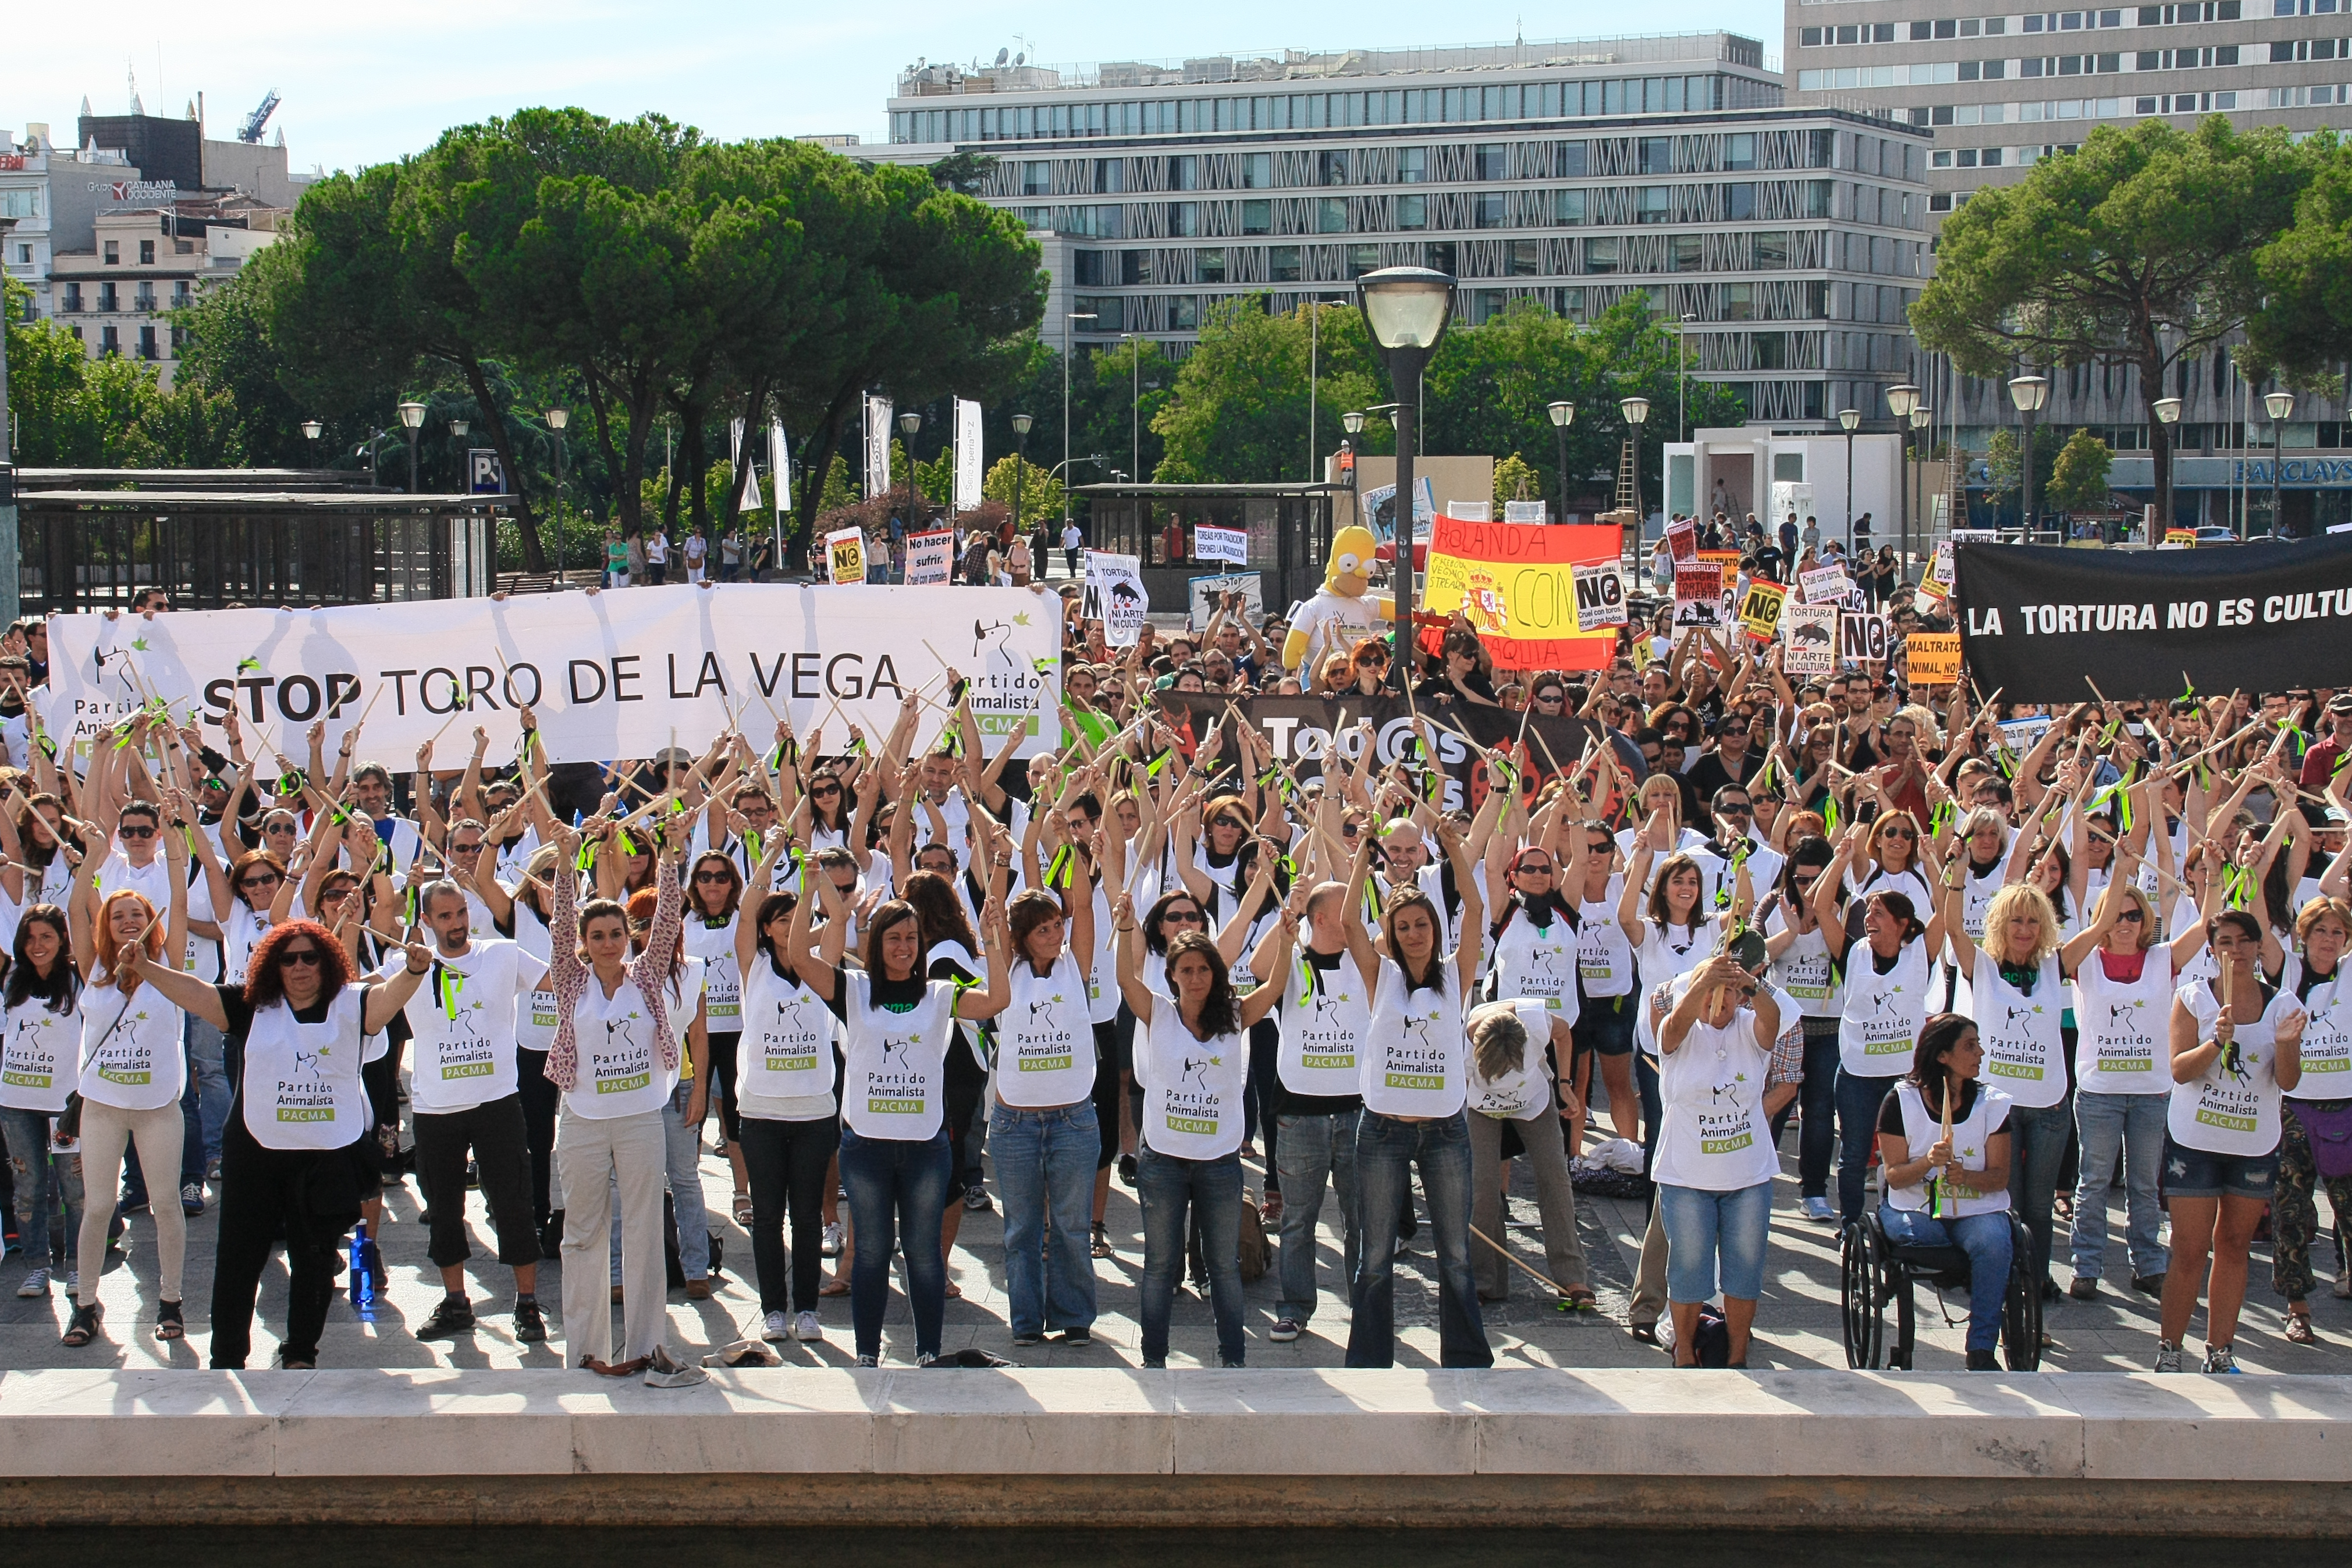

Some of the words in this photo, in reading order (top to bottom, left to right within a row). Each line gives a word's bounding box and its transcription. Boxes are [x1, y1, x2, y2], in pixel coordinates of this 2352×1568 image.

[88, 181, 113, 192] Grupo
[126, 180, 176, 190] CATALANA
[127, 189, 176, 200] OCCIDENTE
[965, 468, 974, 491] Serie
[909, 538, 922, 550] No
[924, 535, 952, 547] hacer
[1214, 532, 1223, 541] POR
[1437, 517, 1547, 556] HOLANDA
[1952, 532, 1963, 543] LOS
[833, 540, 858, 550] TORTURA
[1217, 545, 1223, 553] LA
[834, 547, 859, 568] NO
[1939, 544, 1955, 559] Crue
[916, 554, 943, 567] sufrir.
[1101, 568, 1134, 579] TORTURA
[1601, 566, 1616, 574] ANIMAL
[1676, 564, 1720, 573] TORDESILLAS:
[1937, 567, 1954, 580] cruel
[907, 573, 919, 585] Cruel
[919, 574, 928, 585] con
[1677, 573, 1719, 582] SANGRE
[1802, 574, 1817, 586] Cruel
[1817, 573, 1827, 583] con
[1826, 568, 1843, 581] toros,
[1576, 574, 1621, 610] NO
[1677, 582, 1719, 591] TORTURA
[1514, 568, 1573, 628] CON
[1677, 591, 1720, 600] MUERTE
[1807, 589, 1821, 602] cruel
[1820, 589, 1830, 599] con
[1829, 584, 1846, 596] todos.
[1841, 589, 1863, 609] NO
[1578, 610, 1593, 619] Cruel
[1593, 609, 1605, 617] con
[1605, 607, 1623, 617] toros,
[1745, 592, 1781, 623] NO
[1789, 607, 1834, 618] TORTURA
[1111, 609, 1122, 618] NI
[1123, 610, 1145, 620] ARTE
[1968, 607, 2003, 637] LA
[2020, 603, 2157, 635] TORTURA
[2166, 600, 2208, 630] NO
[2217, 598, 2254, 627] ES
[1113, 620, 1120, 628] NI
[1579, 618, 1594, 627] cruel
[1594, 617, 1605, 625] con
[1605, 615, 1624, 625] todos.
[1844, 616, 1885, 659] NO
[1907, 641, 1962, 653] MALTRATO
[1787, 652, 1799, 662] NI
[1800, 652, 1832, 662] ARTE
[1786, 662, 1795, 671] NI
[1795, 662, 1831, 671] CULTURA
[1944, 662, 1959, 674] NO!
[964, 672, 1040, 689] artido
[203, 673, 362, 726] STOP
[380, 662, 542, 716] TORO
[569, 655, 644, 705] DE
[667, 651, 729, 699] LA
[749, 652, 904, 701] VEGA
[74, 698, 151, 715] Partid
[1963, 917, 1982, 926] Part
[1576, 947, 1609, 956] artido
[1579, 957, 1610, 966] imalista
[1582, 969, 1605, 978] ACMA
[1787, 965, 1827, 975] Partid
[1786, 976, 1827, 986] Animalis
[708, 982, 739, 993] rtido
[1520, 987, 1560, 997] Animalis
[531, 991, 556, 1001] Part
[531, 1002, 557, 1013] Anima
[706, 1007, 734, 1016] ACMA
[1863, 1018, 1911, 1031] Partido
[764, 1031, 816, 1043] Partido
[1017, 1032, 1071, 1043] Partido
[1302, 1029, 1355, 1040] Partido
[1864, 1028, 1912, 1041] Animalista
[2097, 1034, 2152, 1045] Partido
[439, 1036, 491, 1053] Partido
[765, 1045, 817, 1055] Animalista
[1018, 1043, 1072, 1056] Animalista
[1302, 1042, 1355, 1053] Animalista
[1869, 1043, 1907, 1054] PACMA
[1990, 1035, 2047, 1053] Partido
[6, 1046, 55, 1063] Partido
[100, 1046, 151, 1058] Partido
[439, 1050, 493, 1065] Animalista
[593, 1047, 649, 1065] Partido
[1386, 1046, 1445, 1061] Partido
[1989, 1048, 2045, 1065] Animalista
[2097, 1047, 2152, 1057] Animalista
[770, 1058, 809, 1069] PACMA
[1023, 1058, 1066, 1070] PACMA
[1306, 1057, 1349, 1067] PACMA
[1385, 1059, 1445, 1073] Animalista
[2102, 1060, 2146, 1071] PACMA
[2303, 1061, 2345, 1071] PACMA
[446, 1064, 488, 1078] PACMA
[594, 1060, 650, 1078] Animalista
[1992, 1063, 2036, 1079] PACMA
[4, 1072, 44, 1086] PACMA
[102, 1069, 143, 1083] PACMA
[868, 1072, 925, 1084] Partido
[278, 1081, 333, 1093] Partido
[602, 1078, 645, 1092] PACMA
[1391, 1076, 1437, 1089] PACMA
[867, 1086, 925, 1097] Animalista
[1166, 1089, 1220, 1105] Partido
[2202, 1083, 2259, 1103] Partido
[276, 1094, 334, 1106] Animalista
[2198, 1096, 2258, 1116] Animalista
[872, 1101, 918, 1112] PACMA
[1165, 1103, 1219, 1118] Animalista
[282, 1110, 328, 1121] PACMA
[2201, 1112, 2248, 1130] PACMA
[1170, 1118, 1211, 1133] PACMA
[1707, 1137, 1747, 1153] PACMA
[1939, 1187, 1974, 1198] ACMA
